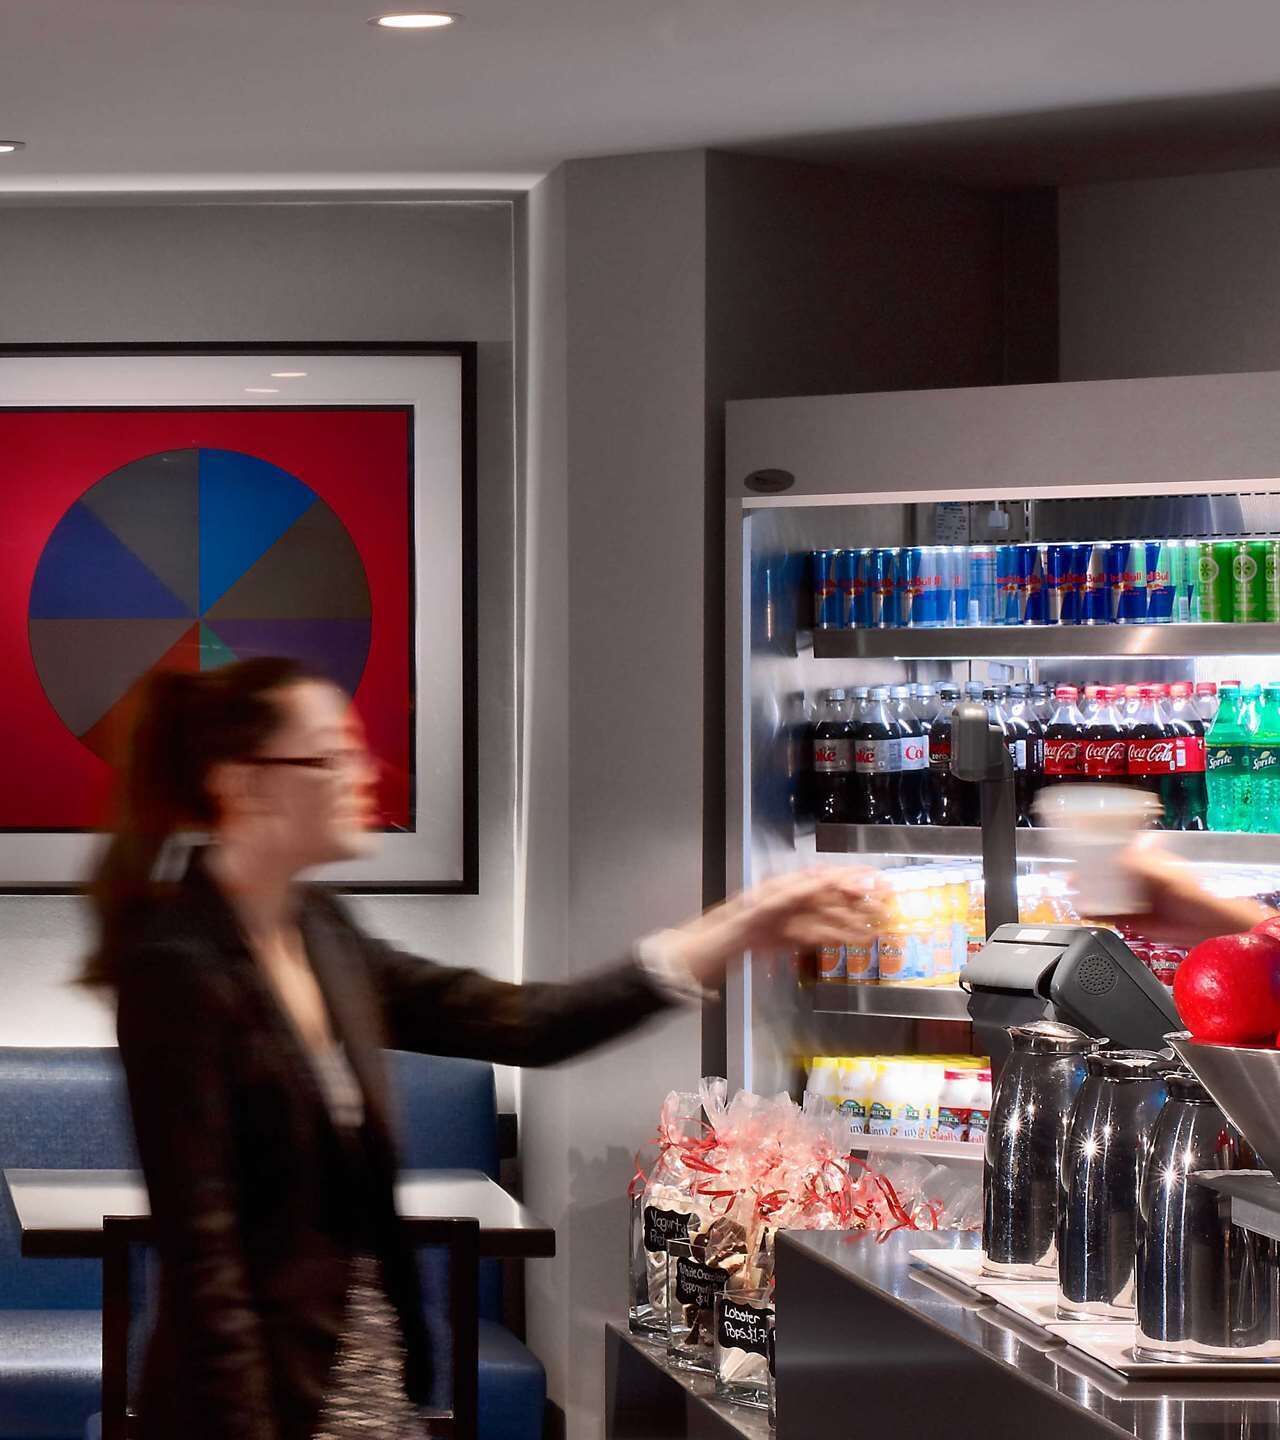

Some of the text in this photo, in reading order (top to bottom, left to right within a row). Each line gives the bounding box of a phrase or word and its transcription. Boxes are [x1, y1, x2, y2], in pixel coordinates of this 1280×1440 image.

[905, 745, 924, 760] Co
[1128, 742, 1174, 762] Coca-Cola
[1208, 755, 1233, 769] Sprite
[1252, 755, 1277, 770] Sprite
[725, 1305, 760, 1324] Lobster
[745, 1325, 768, 1344] $1.7
